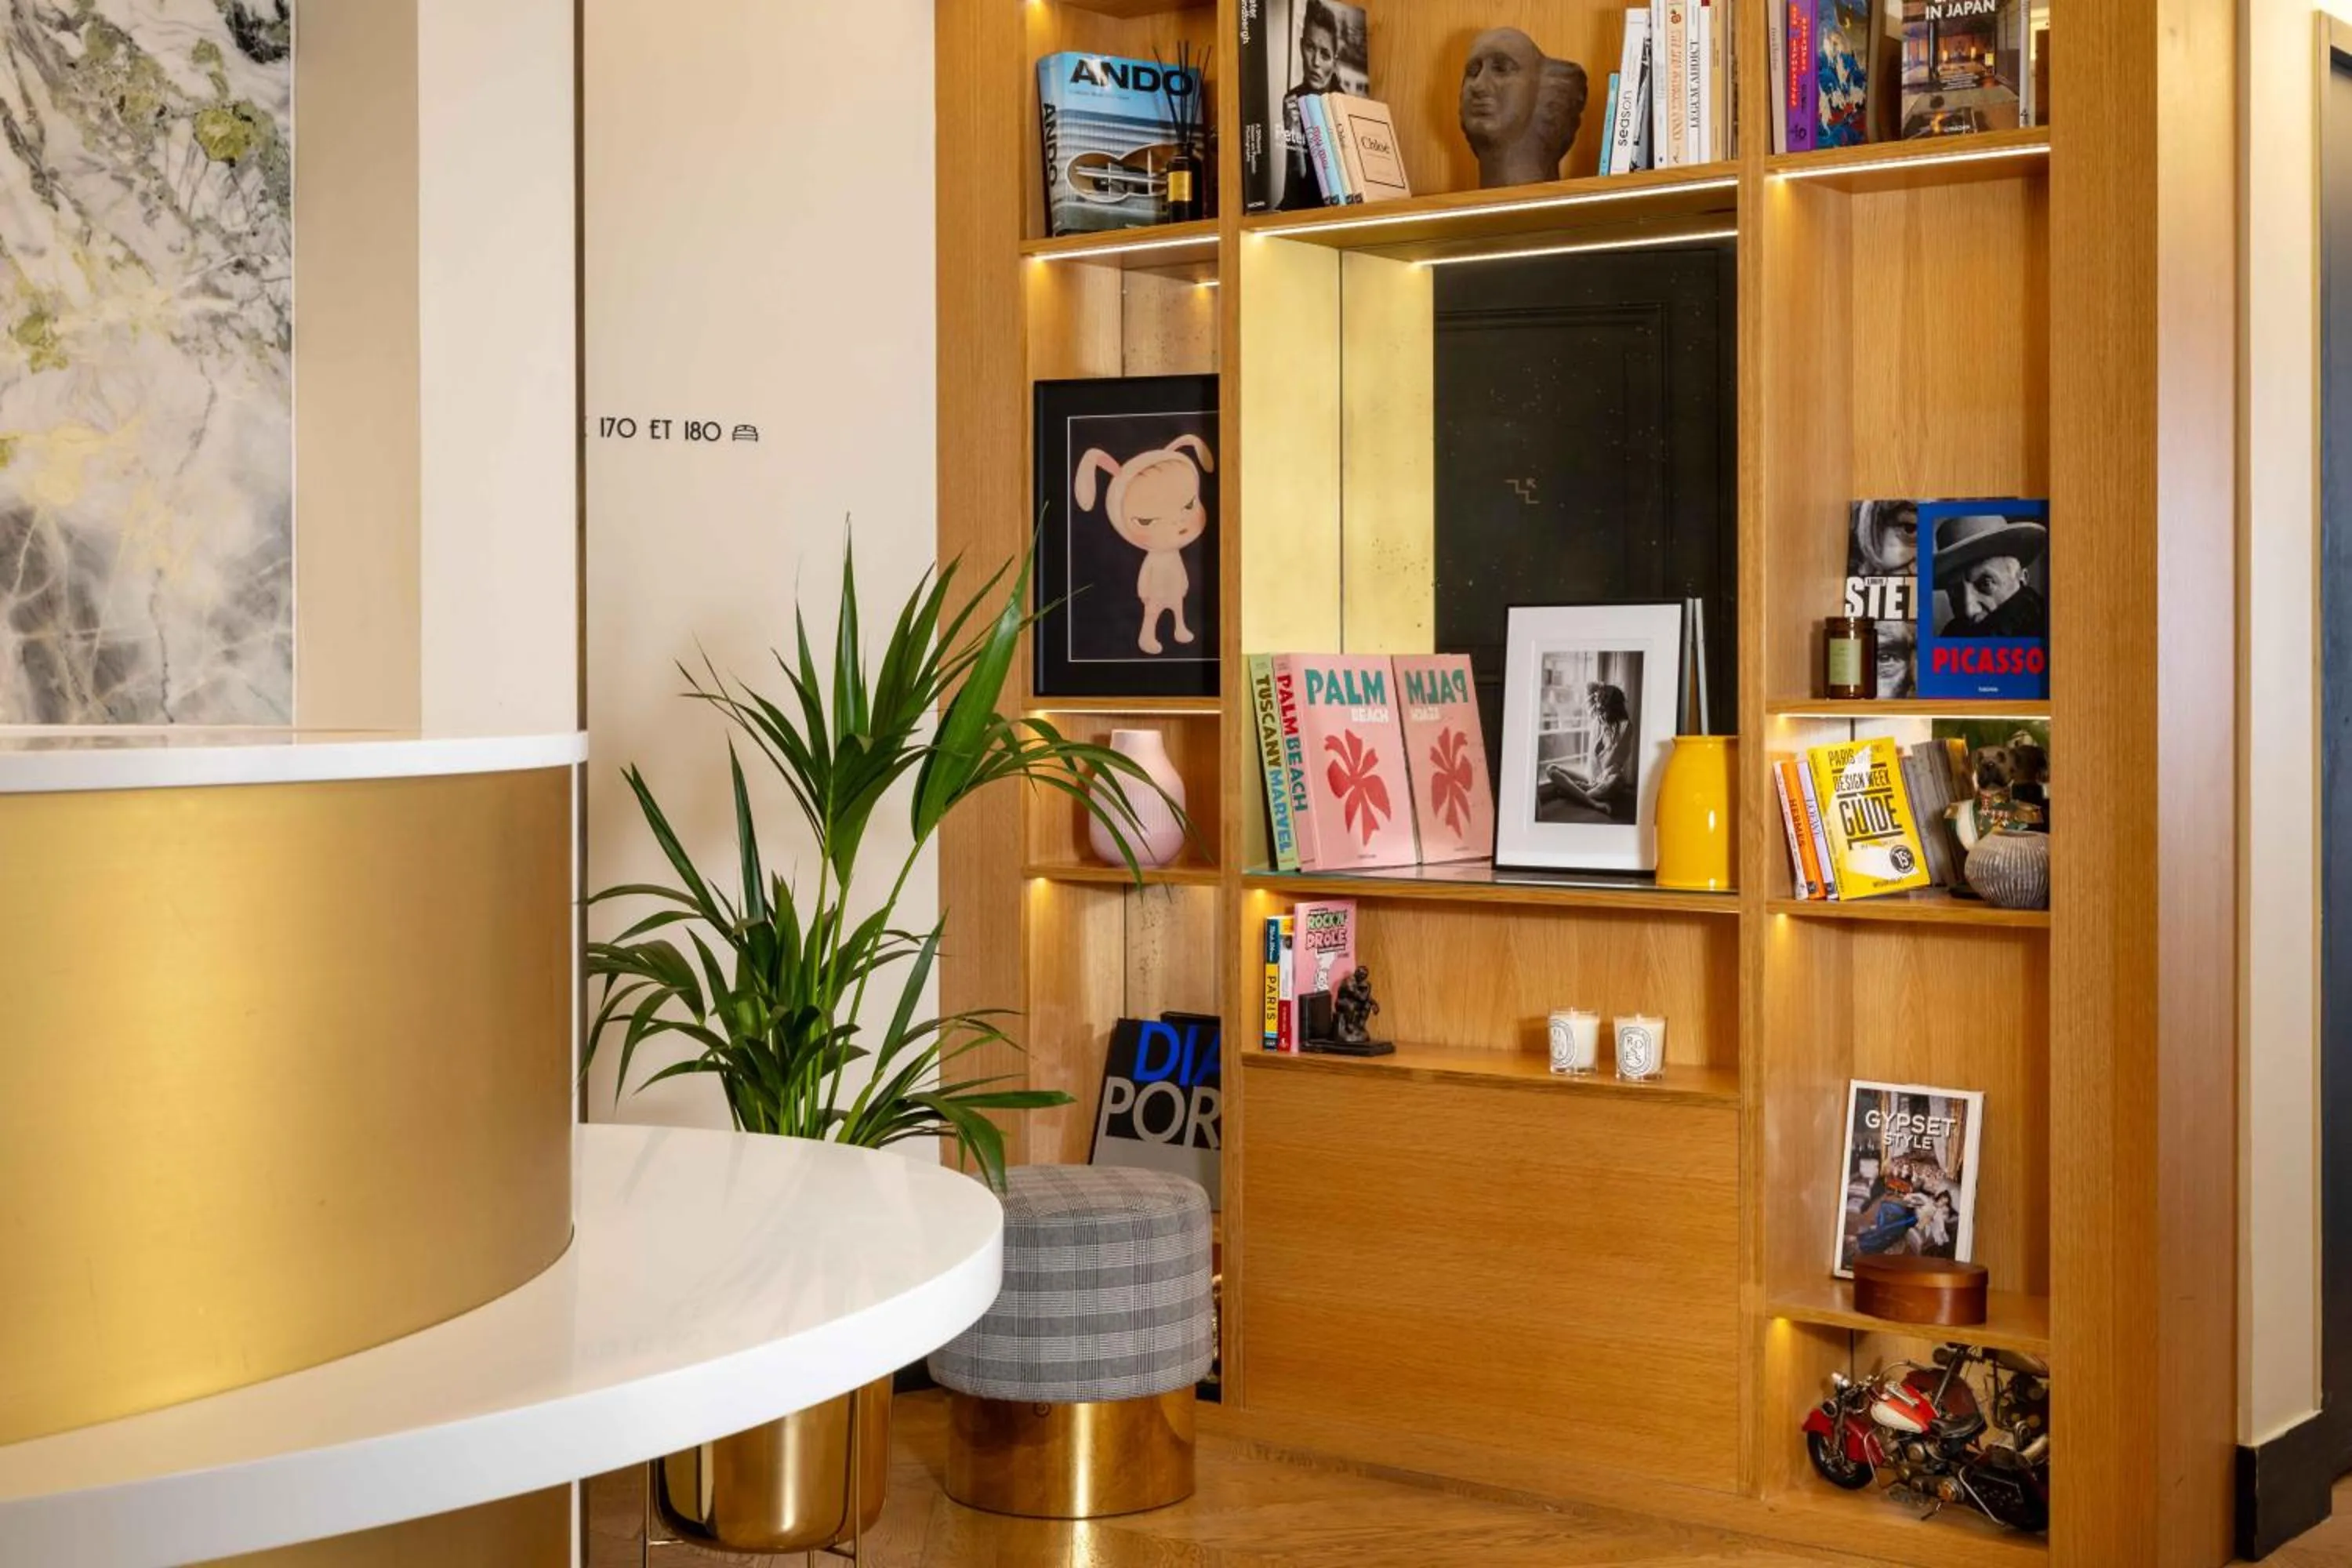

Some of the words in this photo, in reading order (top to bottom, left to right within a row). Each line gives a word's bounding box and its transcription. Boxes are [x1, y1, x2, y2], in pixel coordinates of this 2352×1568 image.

[1925, 5, 1942, 20] IN
[1945, 0, 1995, 18] JAPAN
[1069, 59, 1193, 96] ANDO
[1618, 90, 1632, 147] season
[1044, 103, 1058, 187] ANDO
[600, 417, 637, 438] 170
[650, 419, 672, 440] ET
[684, 421, 721, 441] 180
[1932, 647, 2045, 675] PICASSO
[1276, 673, 1298, 736] PALM
[1305, 669, 1387, 706] PALM
[1256, 674, 1282, 768] TUSCANY
[1269, 768, 1291, 854] MARVEL
[1285, 736, 1308, 811] BEACH
[1828, 748, 1856, 767] PARIS
[1832, 772, 1865, 793] DESIGN
[1867, 768, 1892, 788] WEEK
[1838, 794, 1903, 837] GUIDE
[1266, 975, 1276, 1021] PARIS
[1096, 1075, 1221, 1149] POR
[1864, 1109, 1958, 1138] GYPSET
[1883, 1133, 1934, 1150] STYLE
